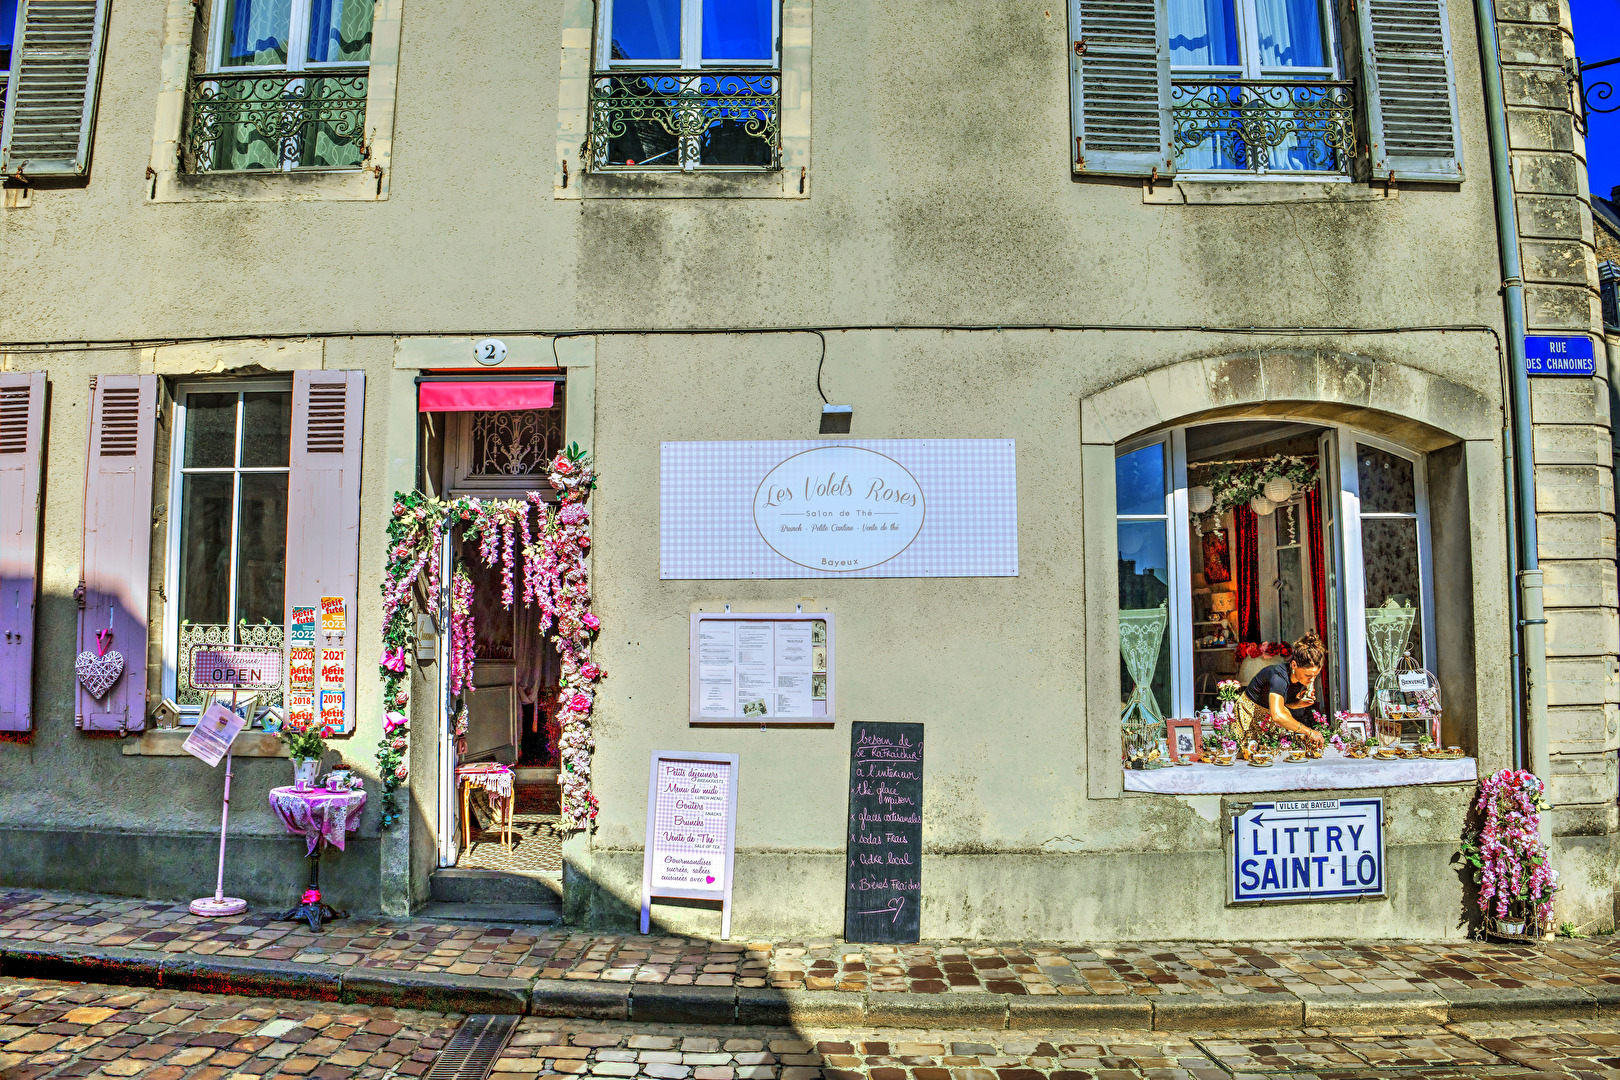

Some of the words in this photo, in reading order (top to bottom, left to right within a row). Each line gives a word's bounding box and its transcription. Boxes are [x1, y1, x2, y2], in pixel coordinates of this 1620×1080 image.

[484, 344, 496, 359] 2
[1549, 342, 1567, 353] RUE
[1526, 358, 1542, 370] DES
[1546, 358, 1593, 370] CHANOINES
[762, 484, 793, 508] Les
[805, 472, 853, 502] Volets
[864, 477, 916, 507] Roses
[806, 510, 833, 518] Salon
[856, 509, 873, 517] Thé
[780, 523, 802, 532] Brunch
[862, 523, 878, 532] Vente
[880, 523, 888, 531] de
[890, 522, 900, 531] thé
[821, 557, 859, 568] Bayeux
[321, 599, 342, 610] petit
[292, 609, 314, 620] petit
[321, 620, 346, 628] 2023
[291, 630, 315, 639] 2022
[214, 654, 261, 665] Welcome
[292, 651, 313, 660] 2020
[323, 651, 344, 660] 2021
[212, 669, 261, 681] OPEN
[291, 667, 313, 676] petit
[322, 667, 344, 676] petit
[293, 697, 311, 705] 2018
[323, 695, 342, 704] 2019
[290, 712, 313, 721] petit
[321, 709, 344, 718] petit
[899, 733, 913, 747] de
[666, 766, 686, 777] Petits
[664, 783, 689, 794] Menu
[691, 785, 700, 794] du
[702, 786, 718, 794] midi
[876, 781, 900, 804] glacé
[676, 799, 704, 810] Goûters
[884, 796, 914, 811] maison
[1279, 802, 1299, 810] VILLE
[1311, 801, 1336, 809] BAYEUX
[663, 831, 685, 842] Vente
[687, 833, 695, 842] de
[697, 834, 715, 843] Thé
[858, 833, 882, 845] sodas
[1253, 824, 1364, 855] LITTRY
[664, 855, 711, 866] Gourmandises
[886, 851, 913, 865] local
[692, 866, 710, 874] salées
